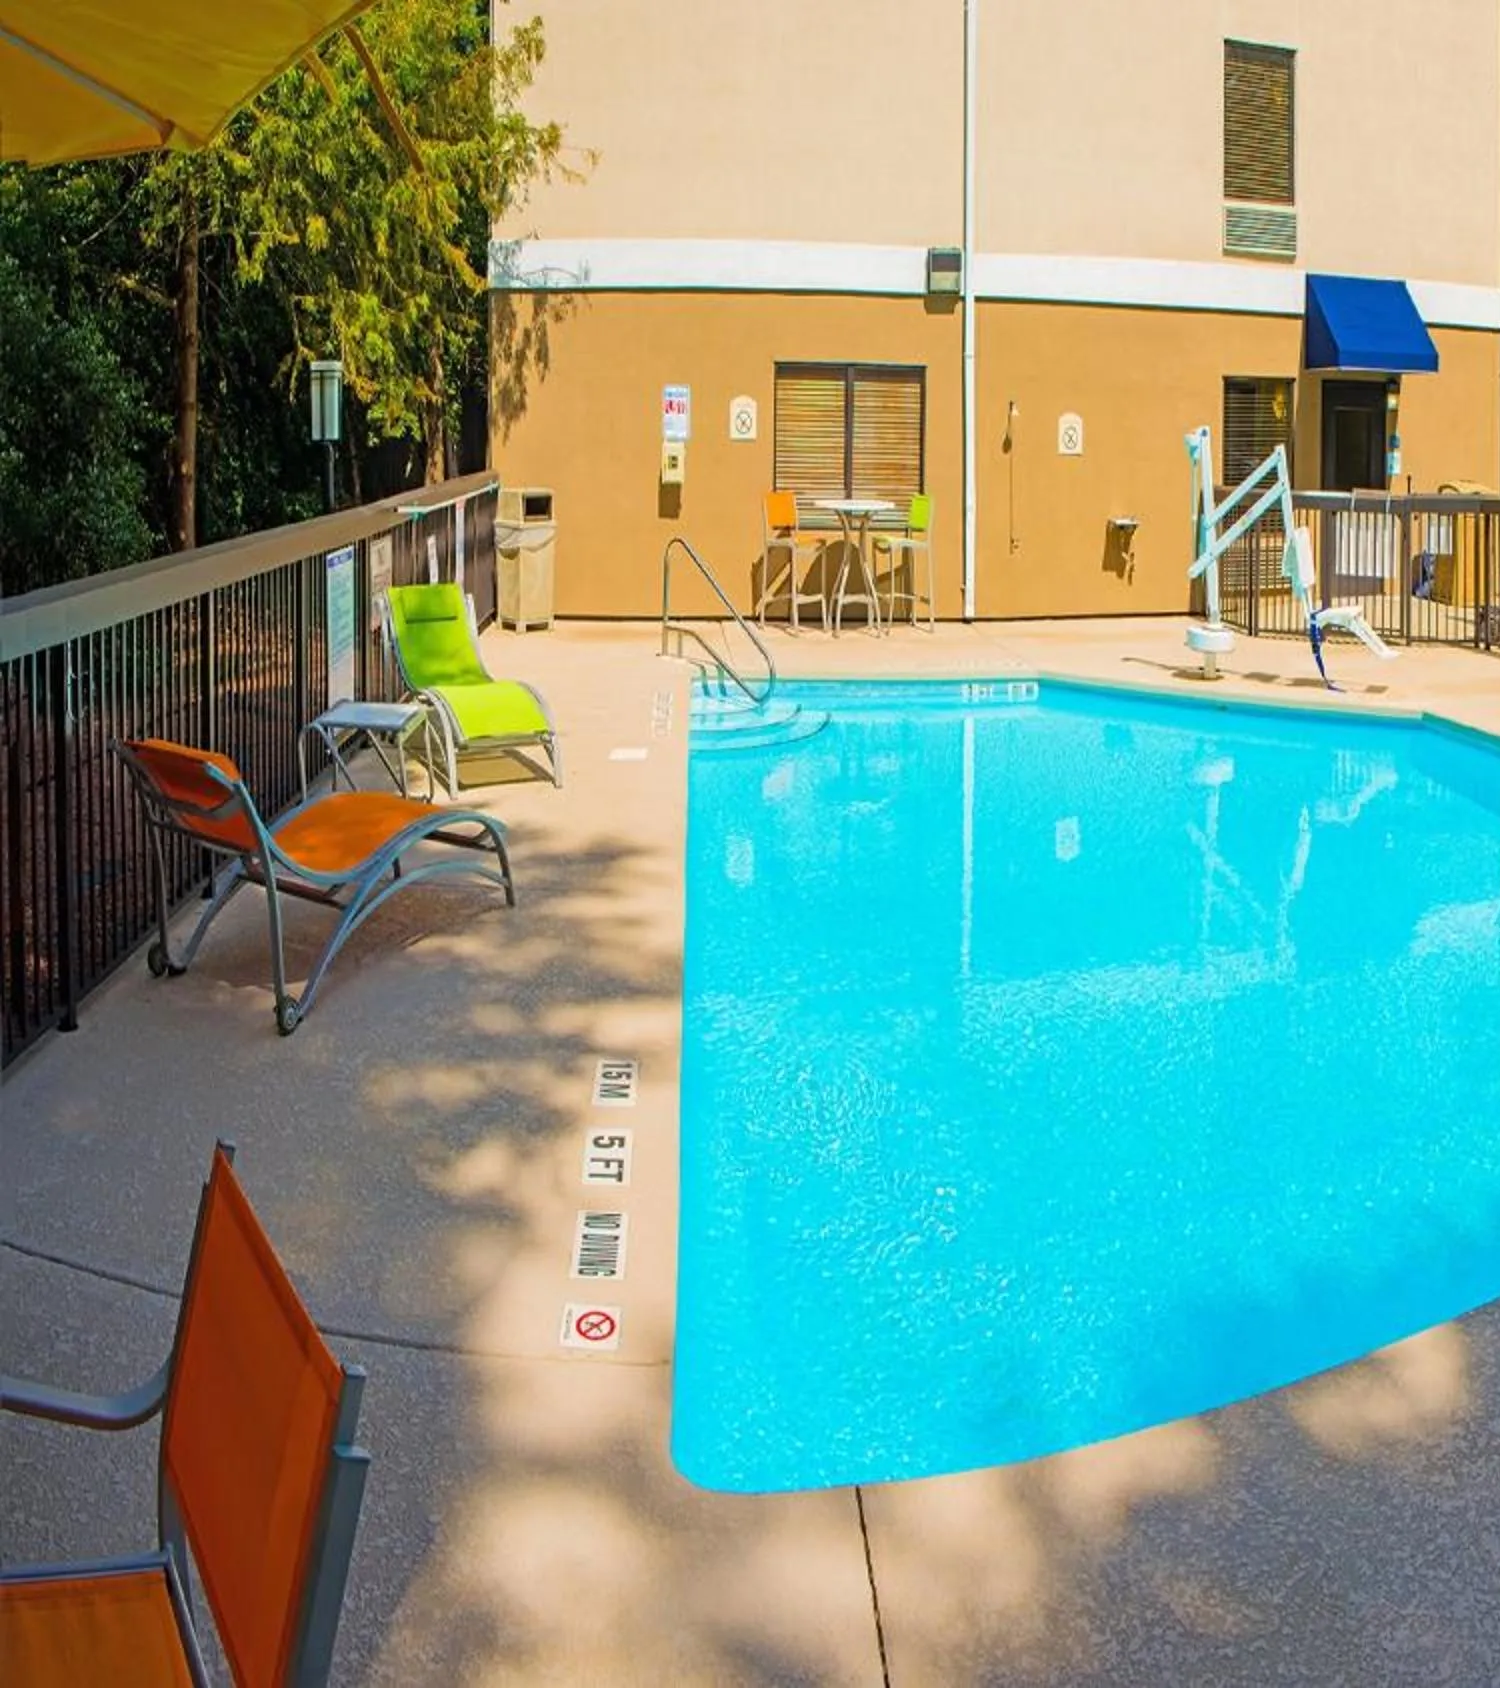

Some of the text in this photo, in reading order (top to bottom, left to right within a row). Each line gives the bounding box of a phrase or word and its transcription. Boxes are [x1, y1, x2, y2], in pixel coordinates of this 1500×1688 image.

[588, 1135, 625, 1182] 5 FT
[578, 1212, 622, 1277] NO DIVING
